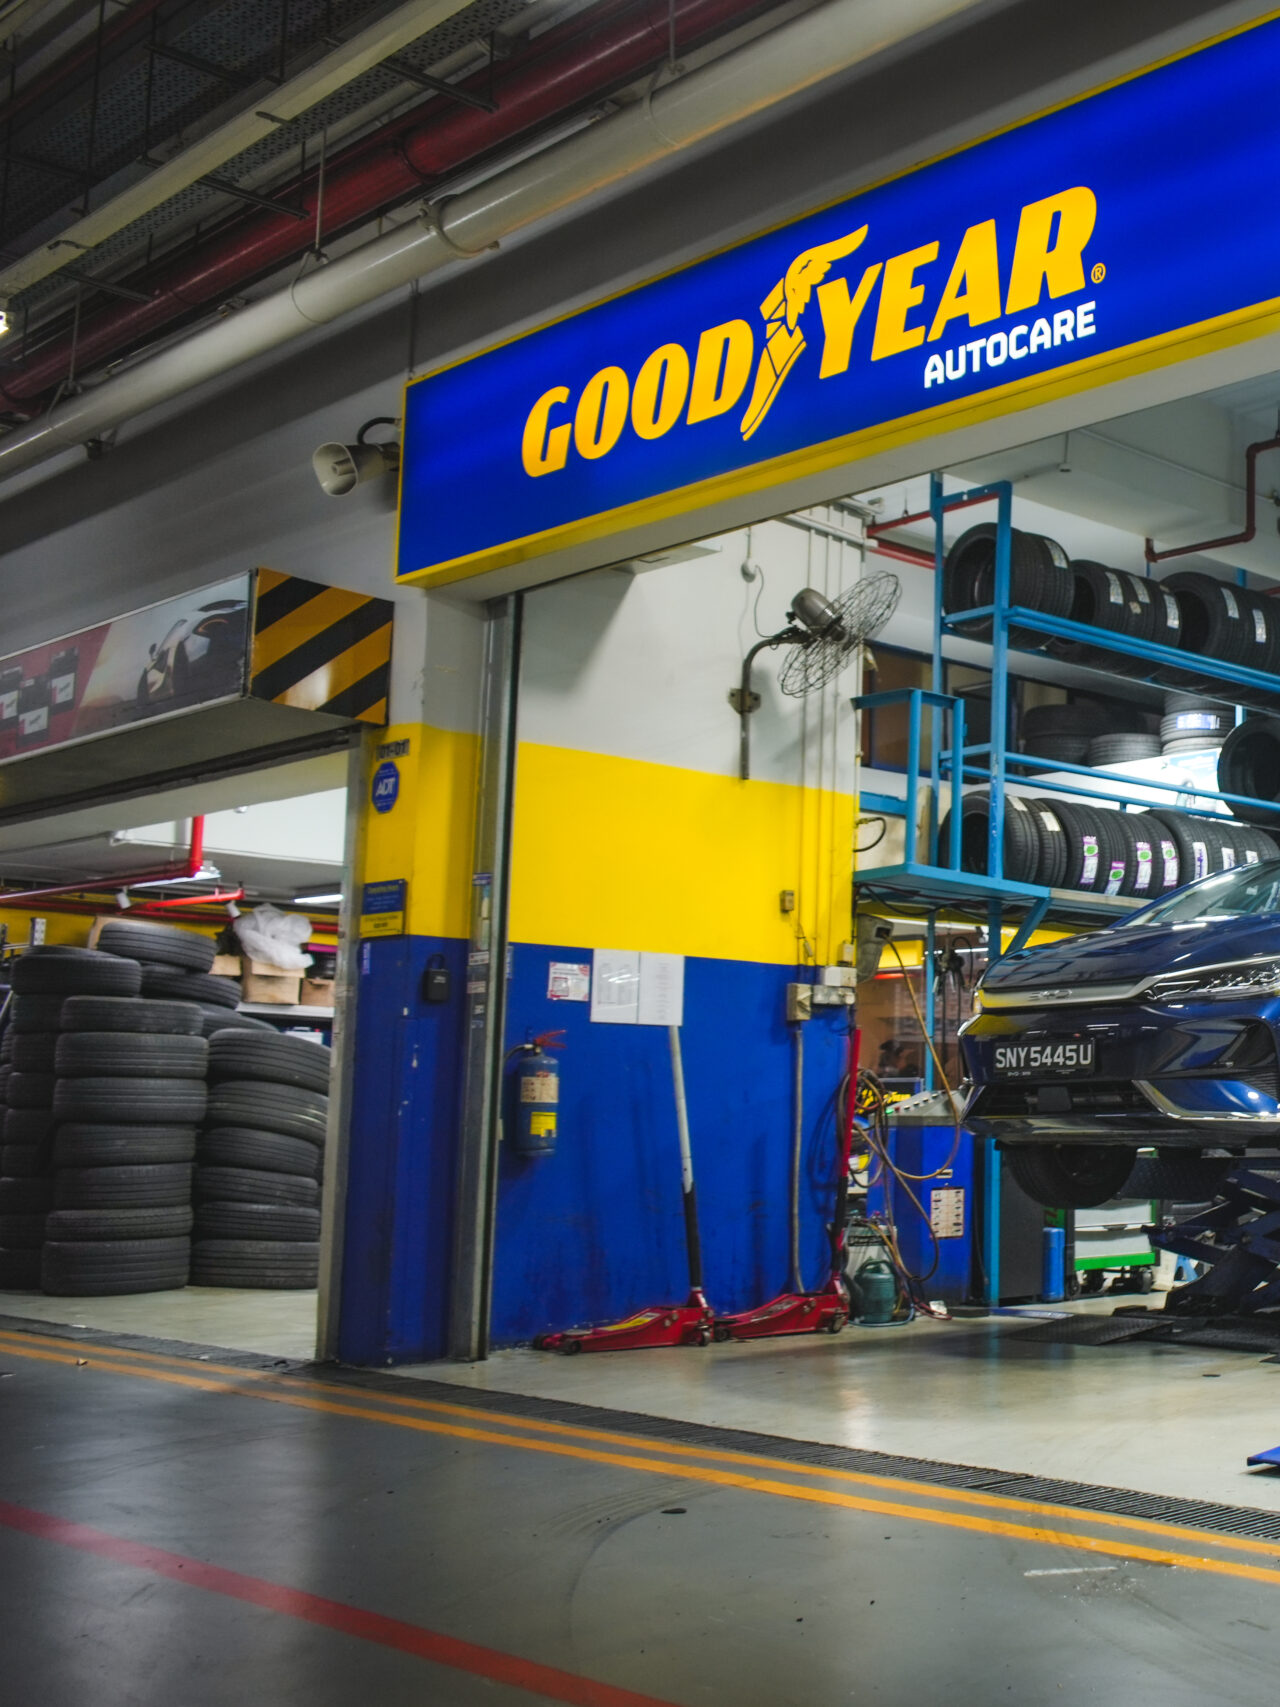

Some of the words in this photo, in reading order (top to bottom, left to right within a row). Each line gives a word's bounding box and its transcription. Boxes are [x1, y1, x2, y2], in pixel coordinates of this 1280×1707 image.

[923, 301, 1097, 389] AUTOCARE
[375, 777, 396, 796] ADT
[994, 1044, 1092, 1069] SNY5445U
